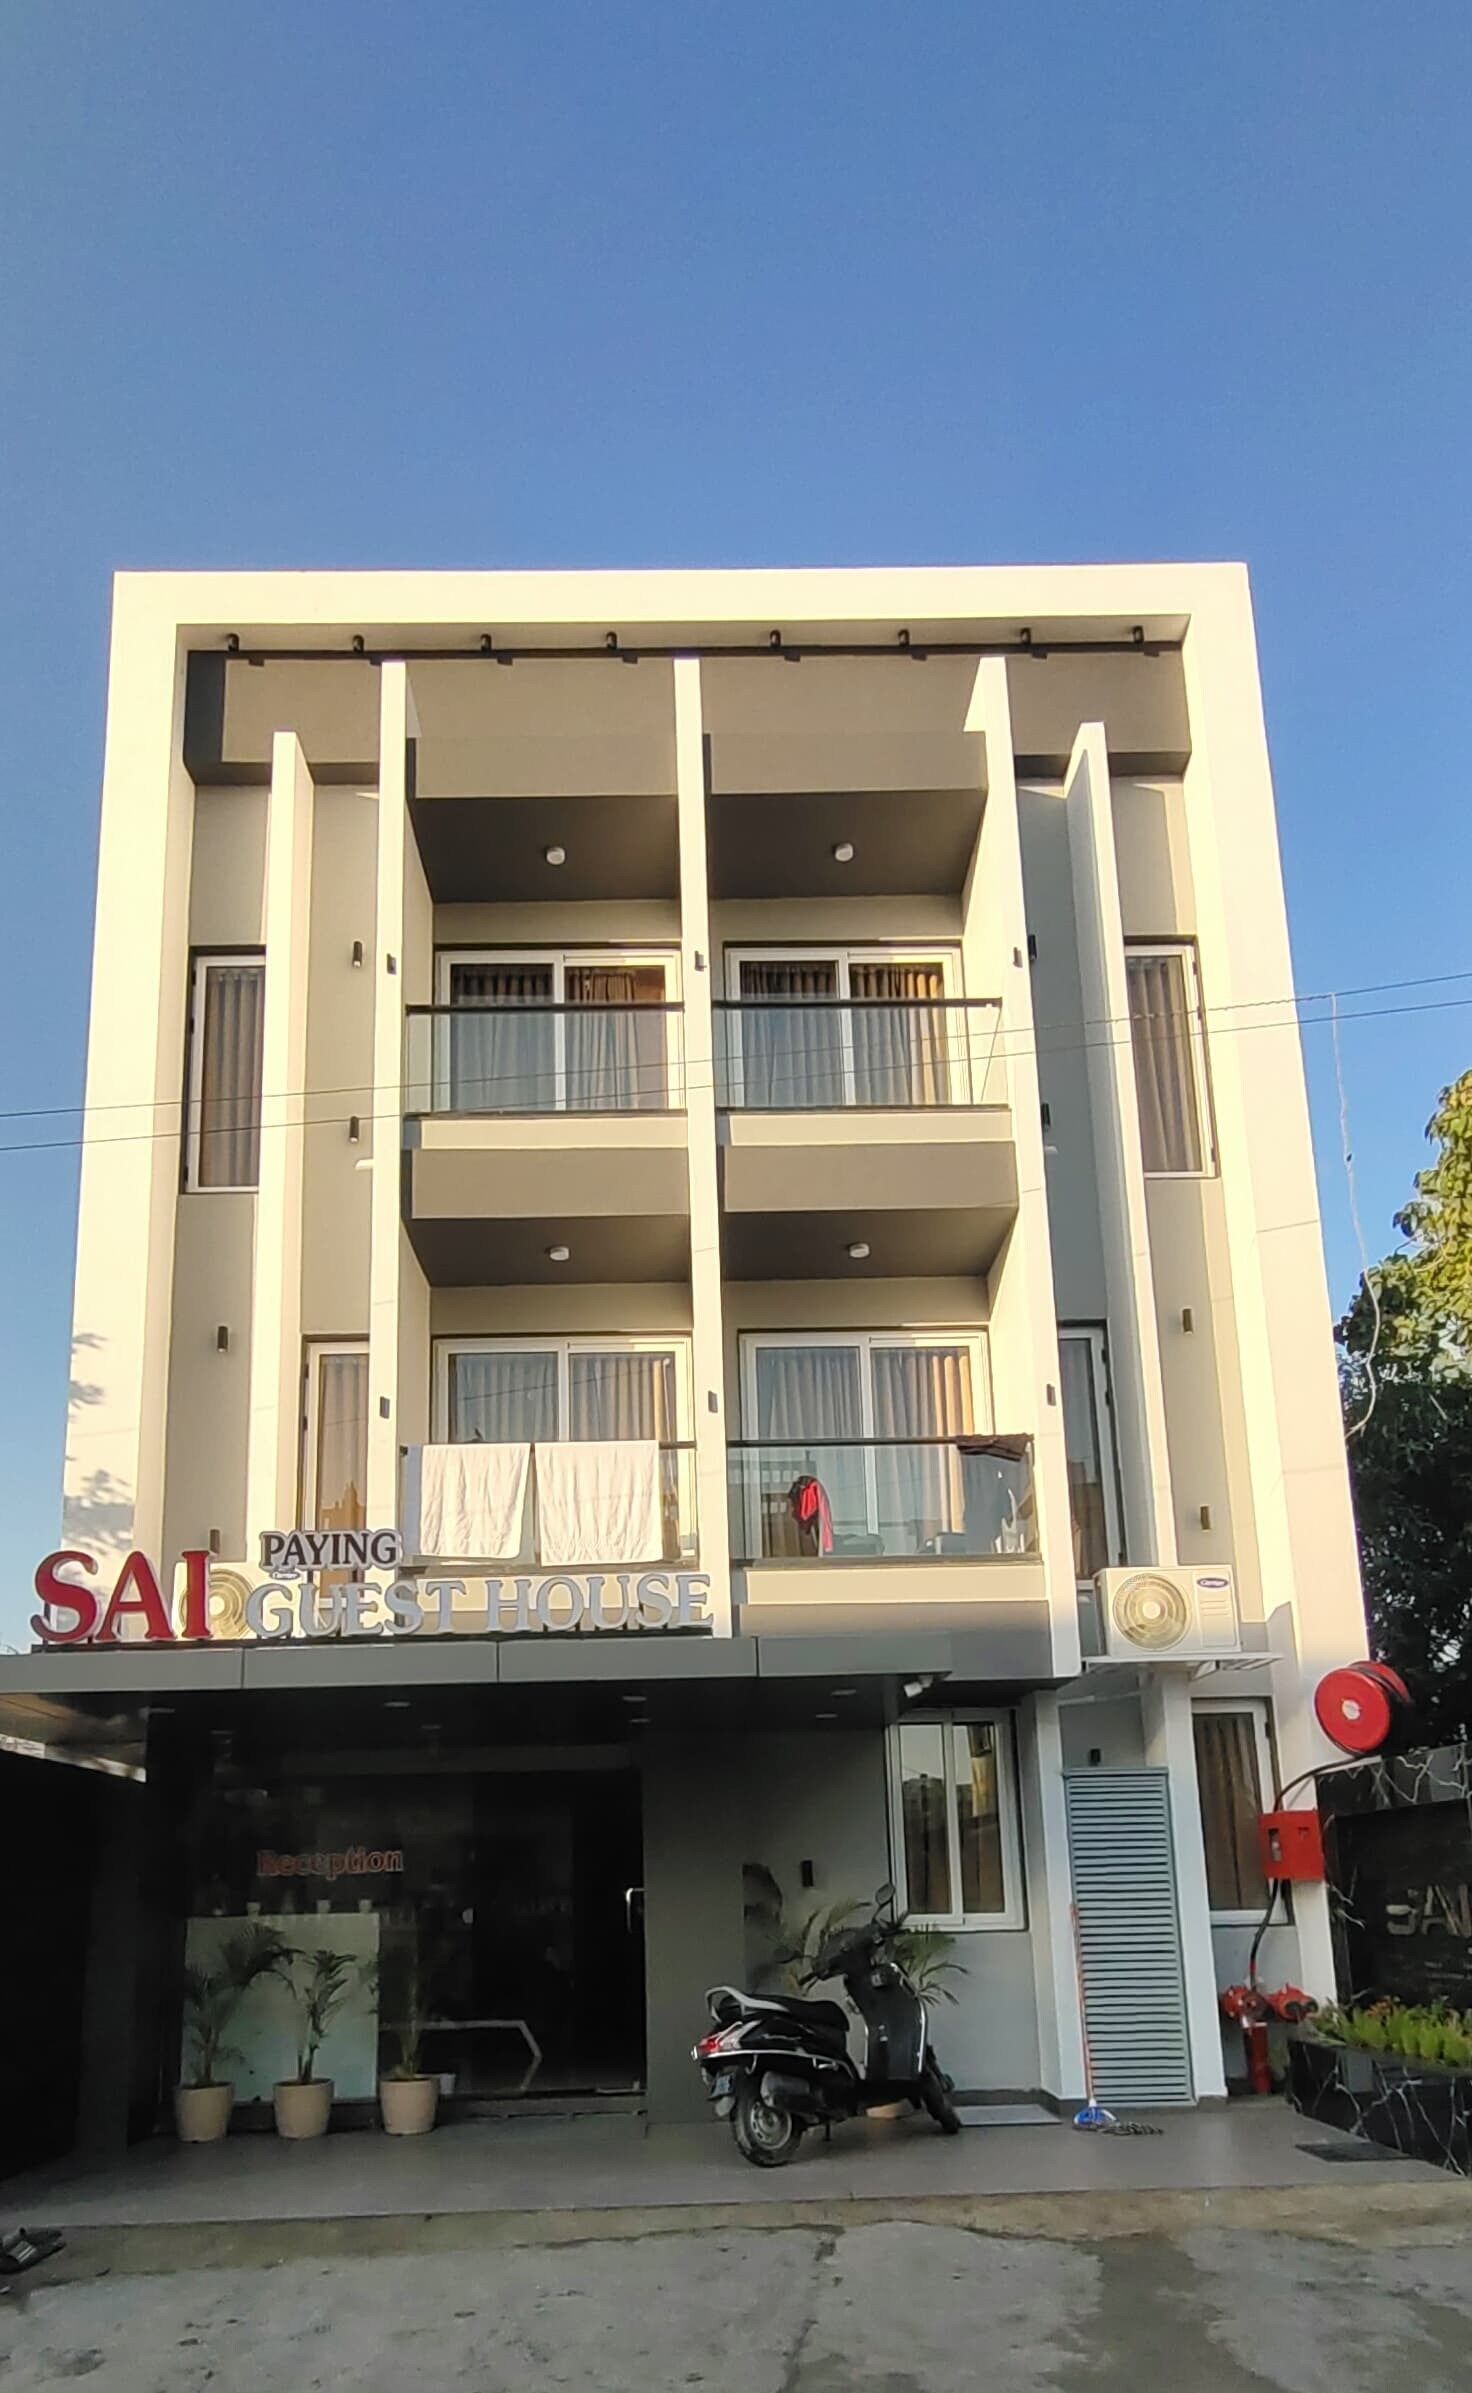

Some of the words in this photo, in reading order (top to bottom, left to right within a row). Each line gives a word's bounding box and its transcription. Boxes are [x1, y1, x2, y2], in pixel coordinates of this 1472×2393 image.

[260, 1529, 400, 1570] PAYING
[30, 1550, 211, 1643] SAI
[245, 1579, 467, 1639] GUEST
[485, 1573, 714, 1632] HOUSE
[256, 1846, 404, 1881] Reception
